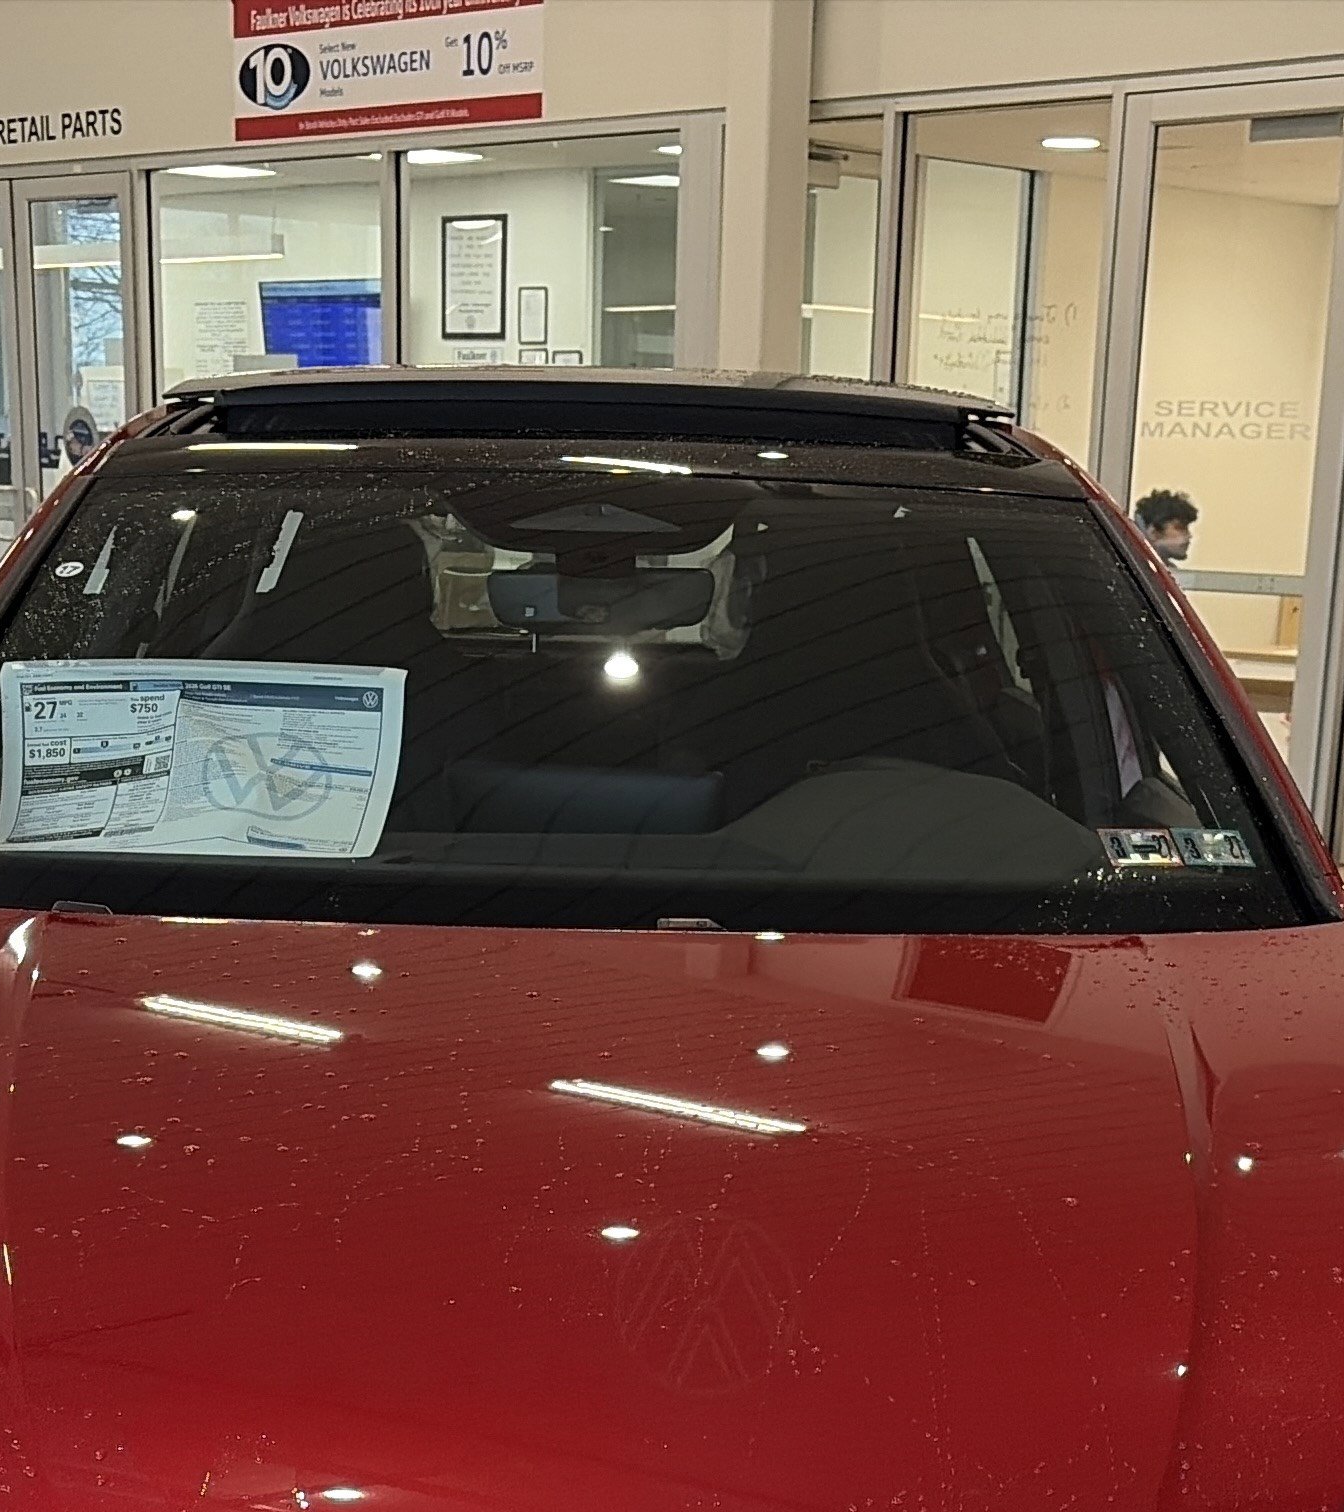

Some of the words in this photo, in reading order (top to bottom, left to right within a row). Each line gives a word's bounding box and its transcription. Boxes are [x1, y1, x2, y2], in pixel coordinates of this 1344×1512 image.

[319, 50, 431, 80] VOLKSWAGEN
[248, 46, 293, 105] 10
[61, 108, 123, 139] PARTS
[1155, 400, 1301, 419] SERVICE
[1141, 421, 1312, 441] MANAGER
[130, 703, 158, 713] $750
[140, 693, 165, 703] spend
[34, 701, 57, 720] 27
[29, 748, 66, 760] $1,850
[1110, 836, 1128, 858] 3
[1183, 837, 1202, 859] 3
